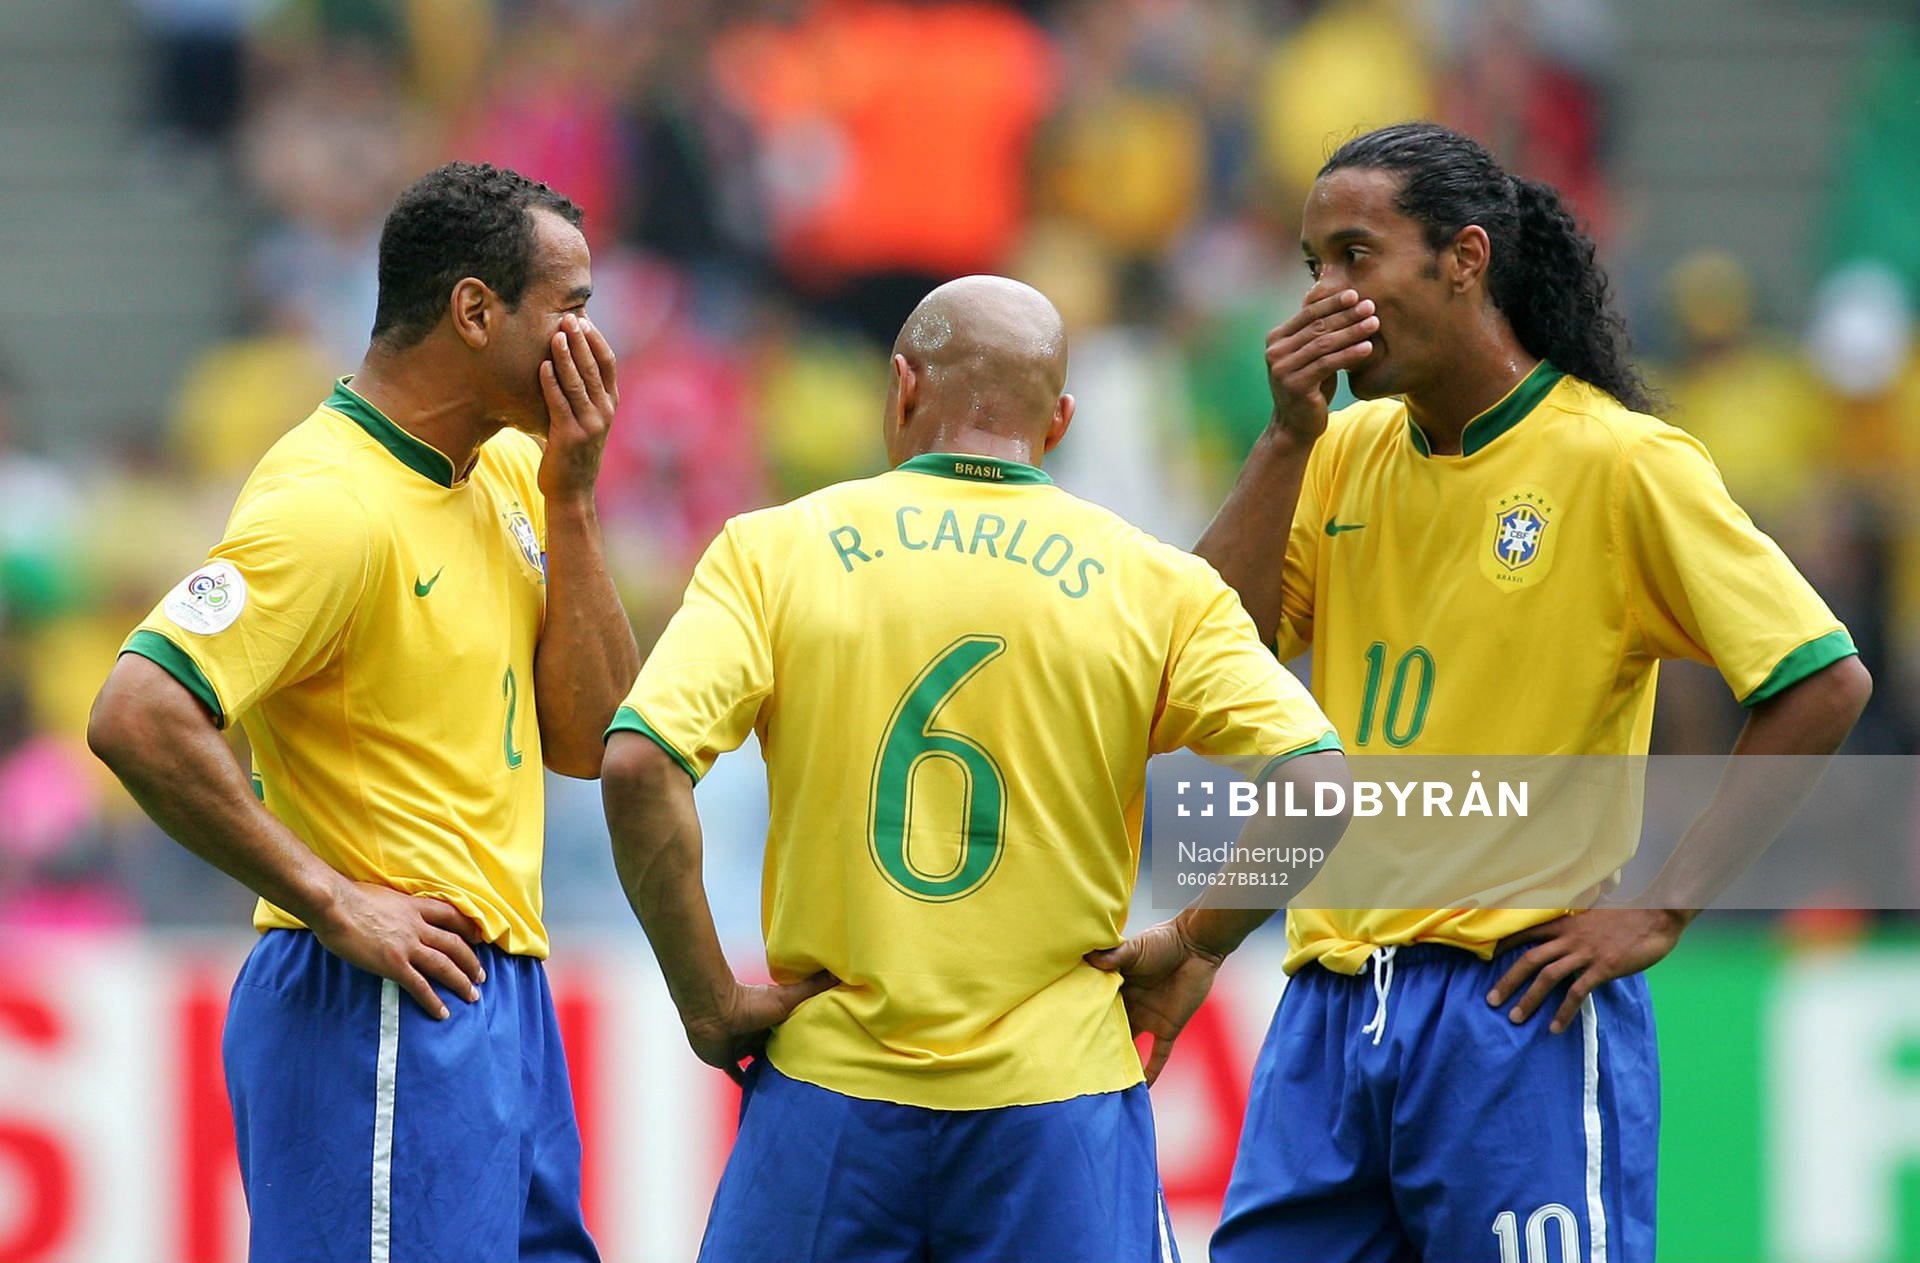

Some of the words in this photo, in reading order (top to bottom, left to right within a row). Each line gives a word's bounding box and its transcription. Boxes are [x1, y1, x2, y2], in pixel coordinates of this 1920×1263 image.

[955, 462, 1004, 479] BRASIL
[828, 525, 884, 573] R.
[896, 506, 1105, 598] CARLOS
[502, 664, 523, 770] 2
[1356, 641, 1436, 749] 10
[867, 633, 1008, 904] 6
